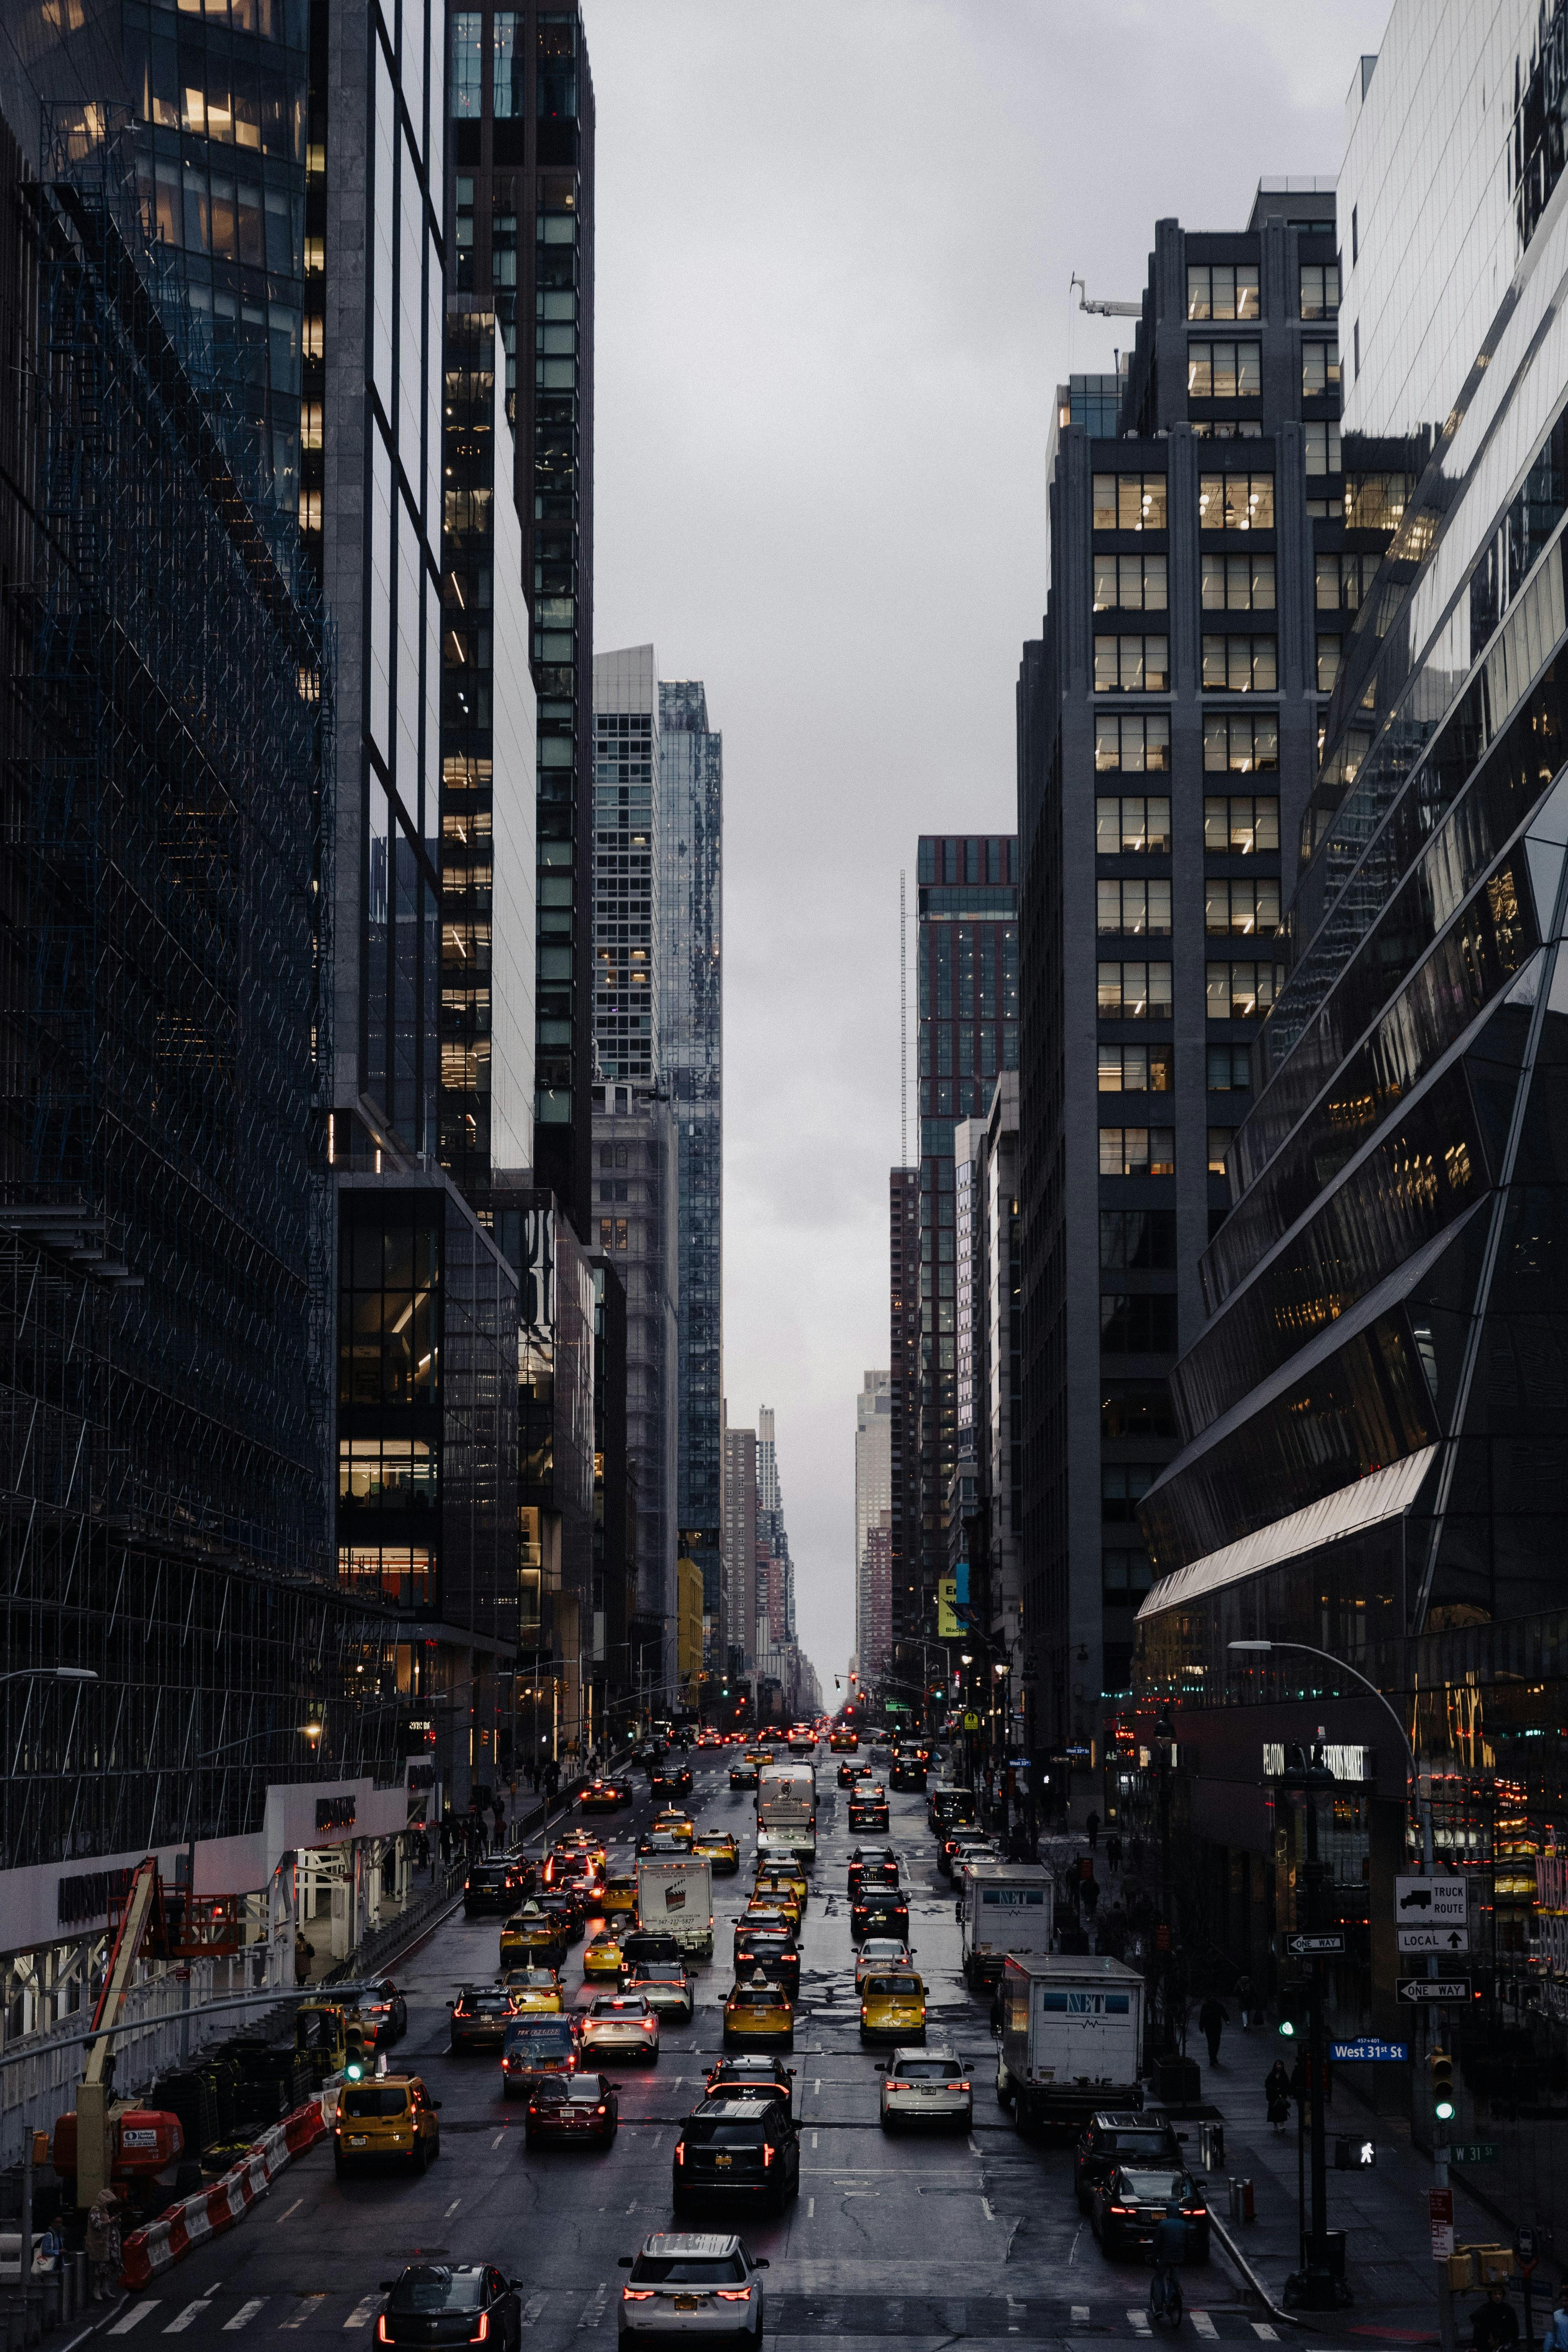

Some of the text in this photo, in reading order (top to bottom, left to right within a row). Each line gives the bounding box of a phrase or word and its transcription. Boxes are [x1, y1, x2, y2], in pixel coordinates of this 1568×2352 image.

[1263, 1743, 1285, 1776] PELOTON
[771, 1794, 803, 1804] Academy
[1434, 1887, 1463, 1897] TRUCK
[1000, 1891, 1027, 1904] NET
[1435, 1904, 1463, 1913] ROUTE
[1319, 1938, 1336, 1947] WAY
[1405, 1936, 1439, 1946] LOCAL
[1408, 1986, 1461, 1996] ONE WAY
[1067, 1993, 1105, 2013] NET
[1335, 2046, 1402, 2058] West 31st St
[1456, 2147, 1492, 2160] W 31 St
